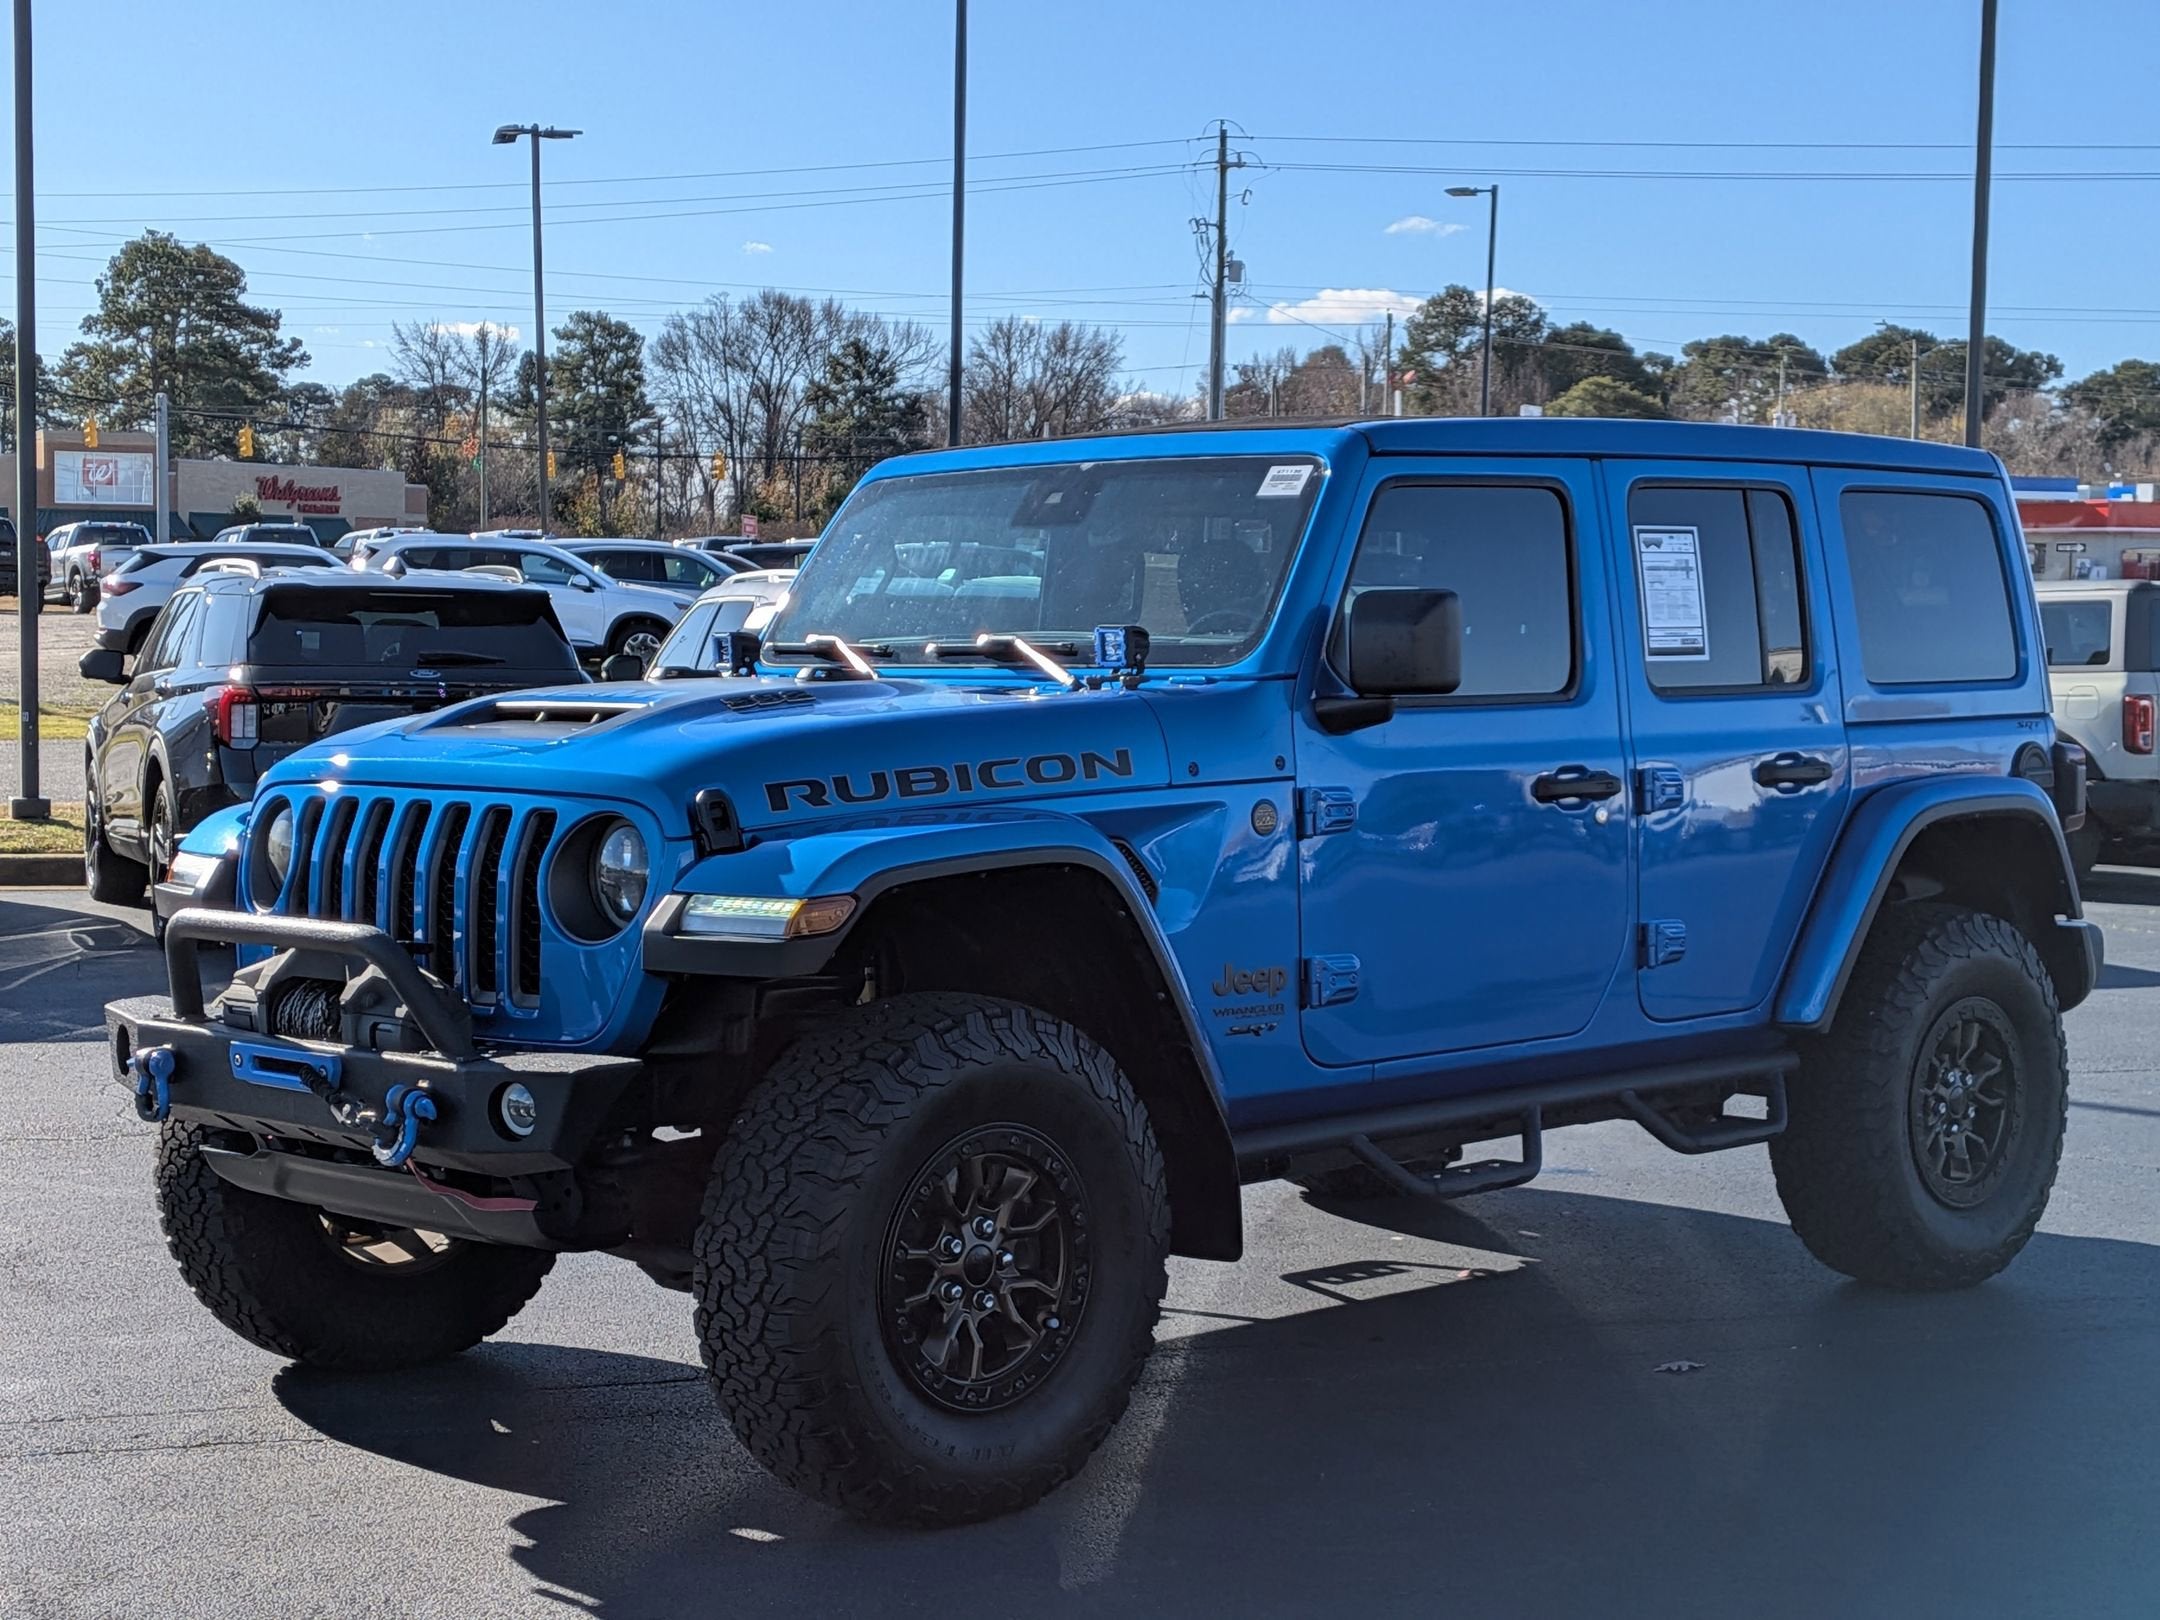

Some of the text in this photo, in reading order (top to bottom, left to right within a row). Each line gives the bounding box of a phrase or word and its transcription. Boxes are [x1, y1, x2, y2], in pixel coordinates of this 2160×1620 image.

[256, 475, 342, 509] Walgreens
[764, 748, 1133, 813] RUBICON
[1212, 963, 1286, 998] Jeep
[1212, 1003, 1285, 1017] WRANGLER
